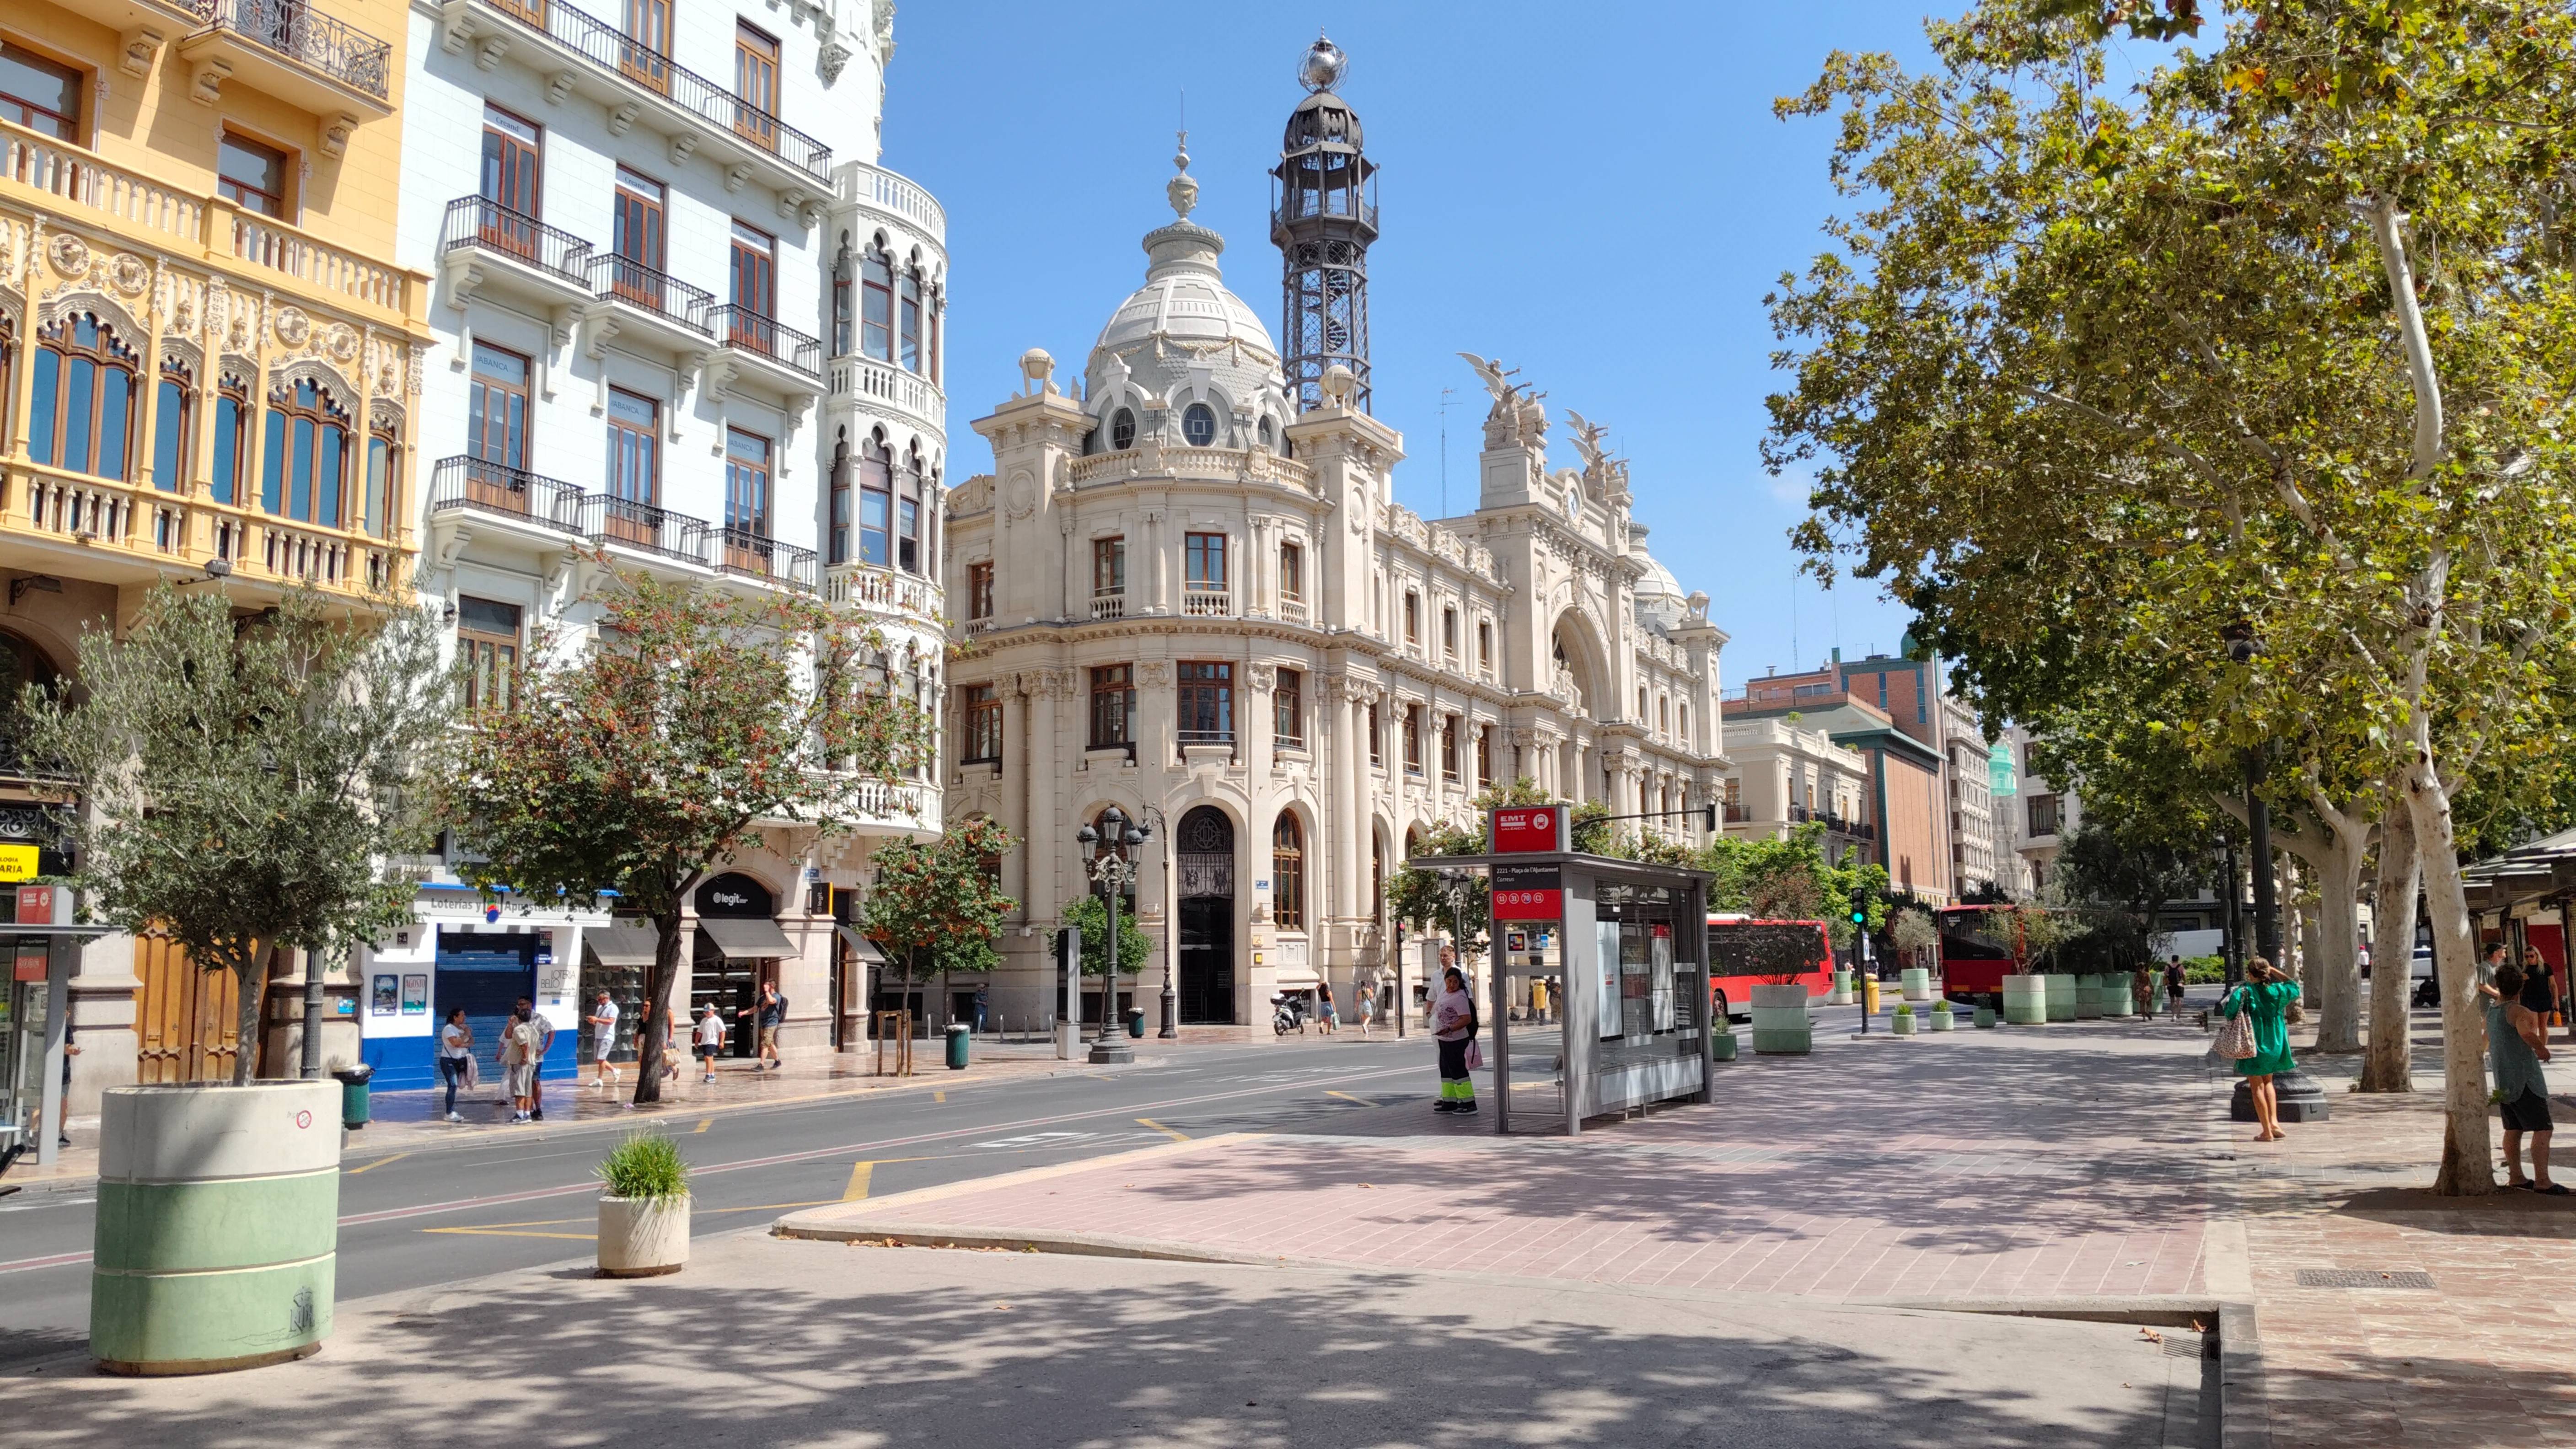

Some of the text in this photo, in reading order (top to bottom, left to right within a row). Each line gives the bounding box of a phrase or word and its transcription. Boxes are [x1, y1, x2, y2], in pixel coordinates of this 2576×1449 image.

[496, 117, 519, 133] Creand
[431, 898, 472, 910] Loterías
[476, 901, 481, 913] y
[722, 893, 740, 906] legit
[405, 979, 425, 988] AGOSTO
